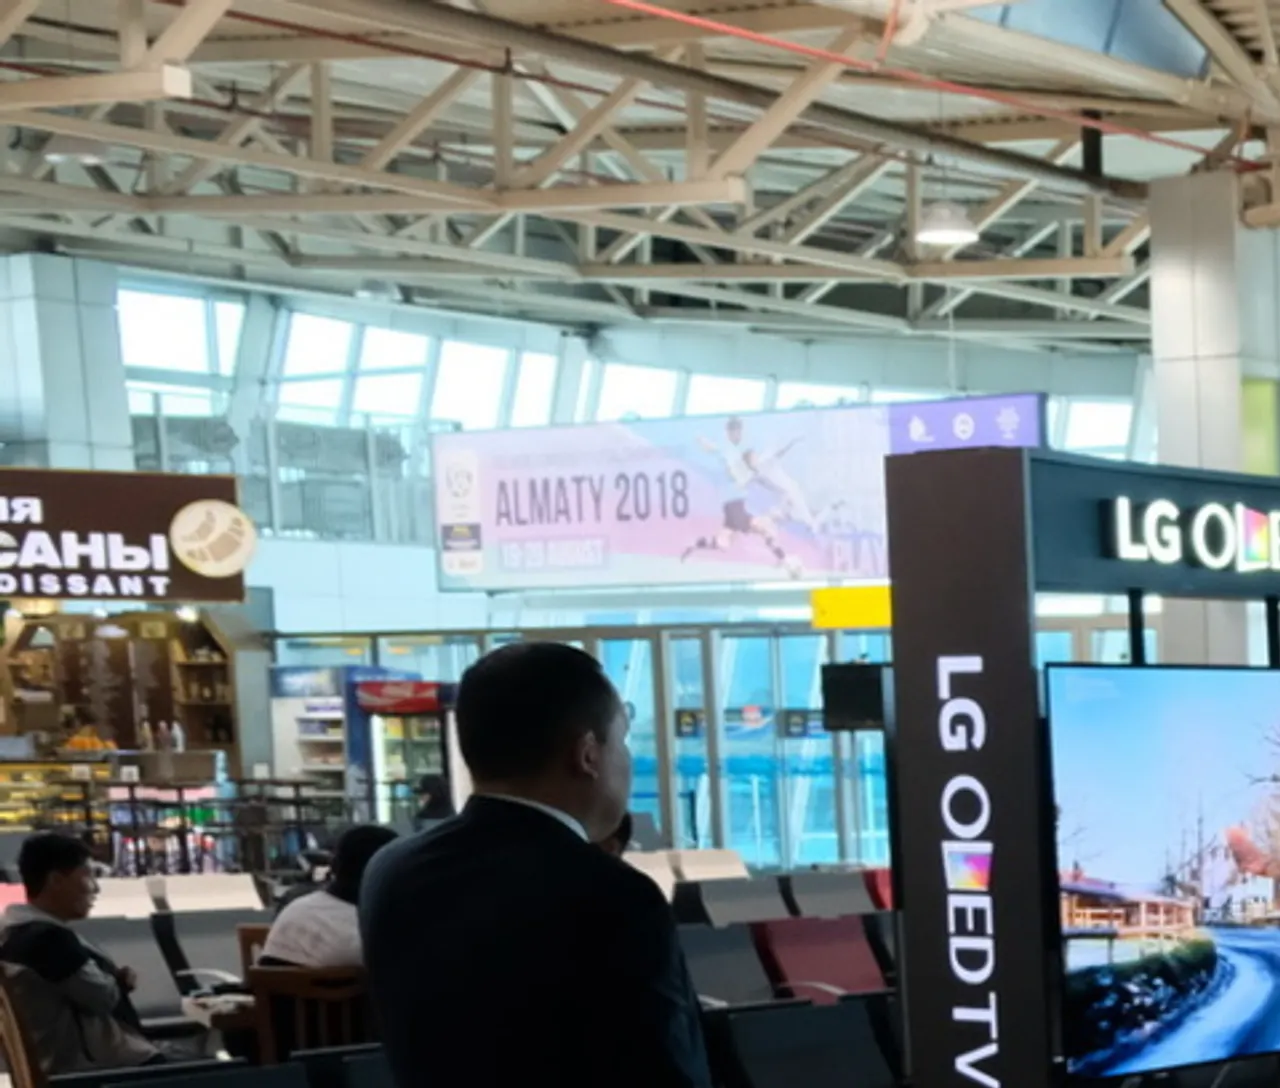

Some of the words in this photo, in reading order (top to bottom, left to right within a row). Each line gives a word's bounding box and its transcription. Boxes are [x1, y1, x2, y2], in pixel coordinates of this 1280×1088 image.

[0, 496, 43, 524] Я
[495, 474, 605, 526] ALMATY
[614, 469, 690, 522] 2018
[1114, 495, 1183, 564] LG
[936, 654, 987, 752] LG
[940, 774, 996, 985] OLED
